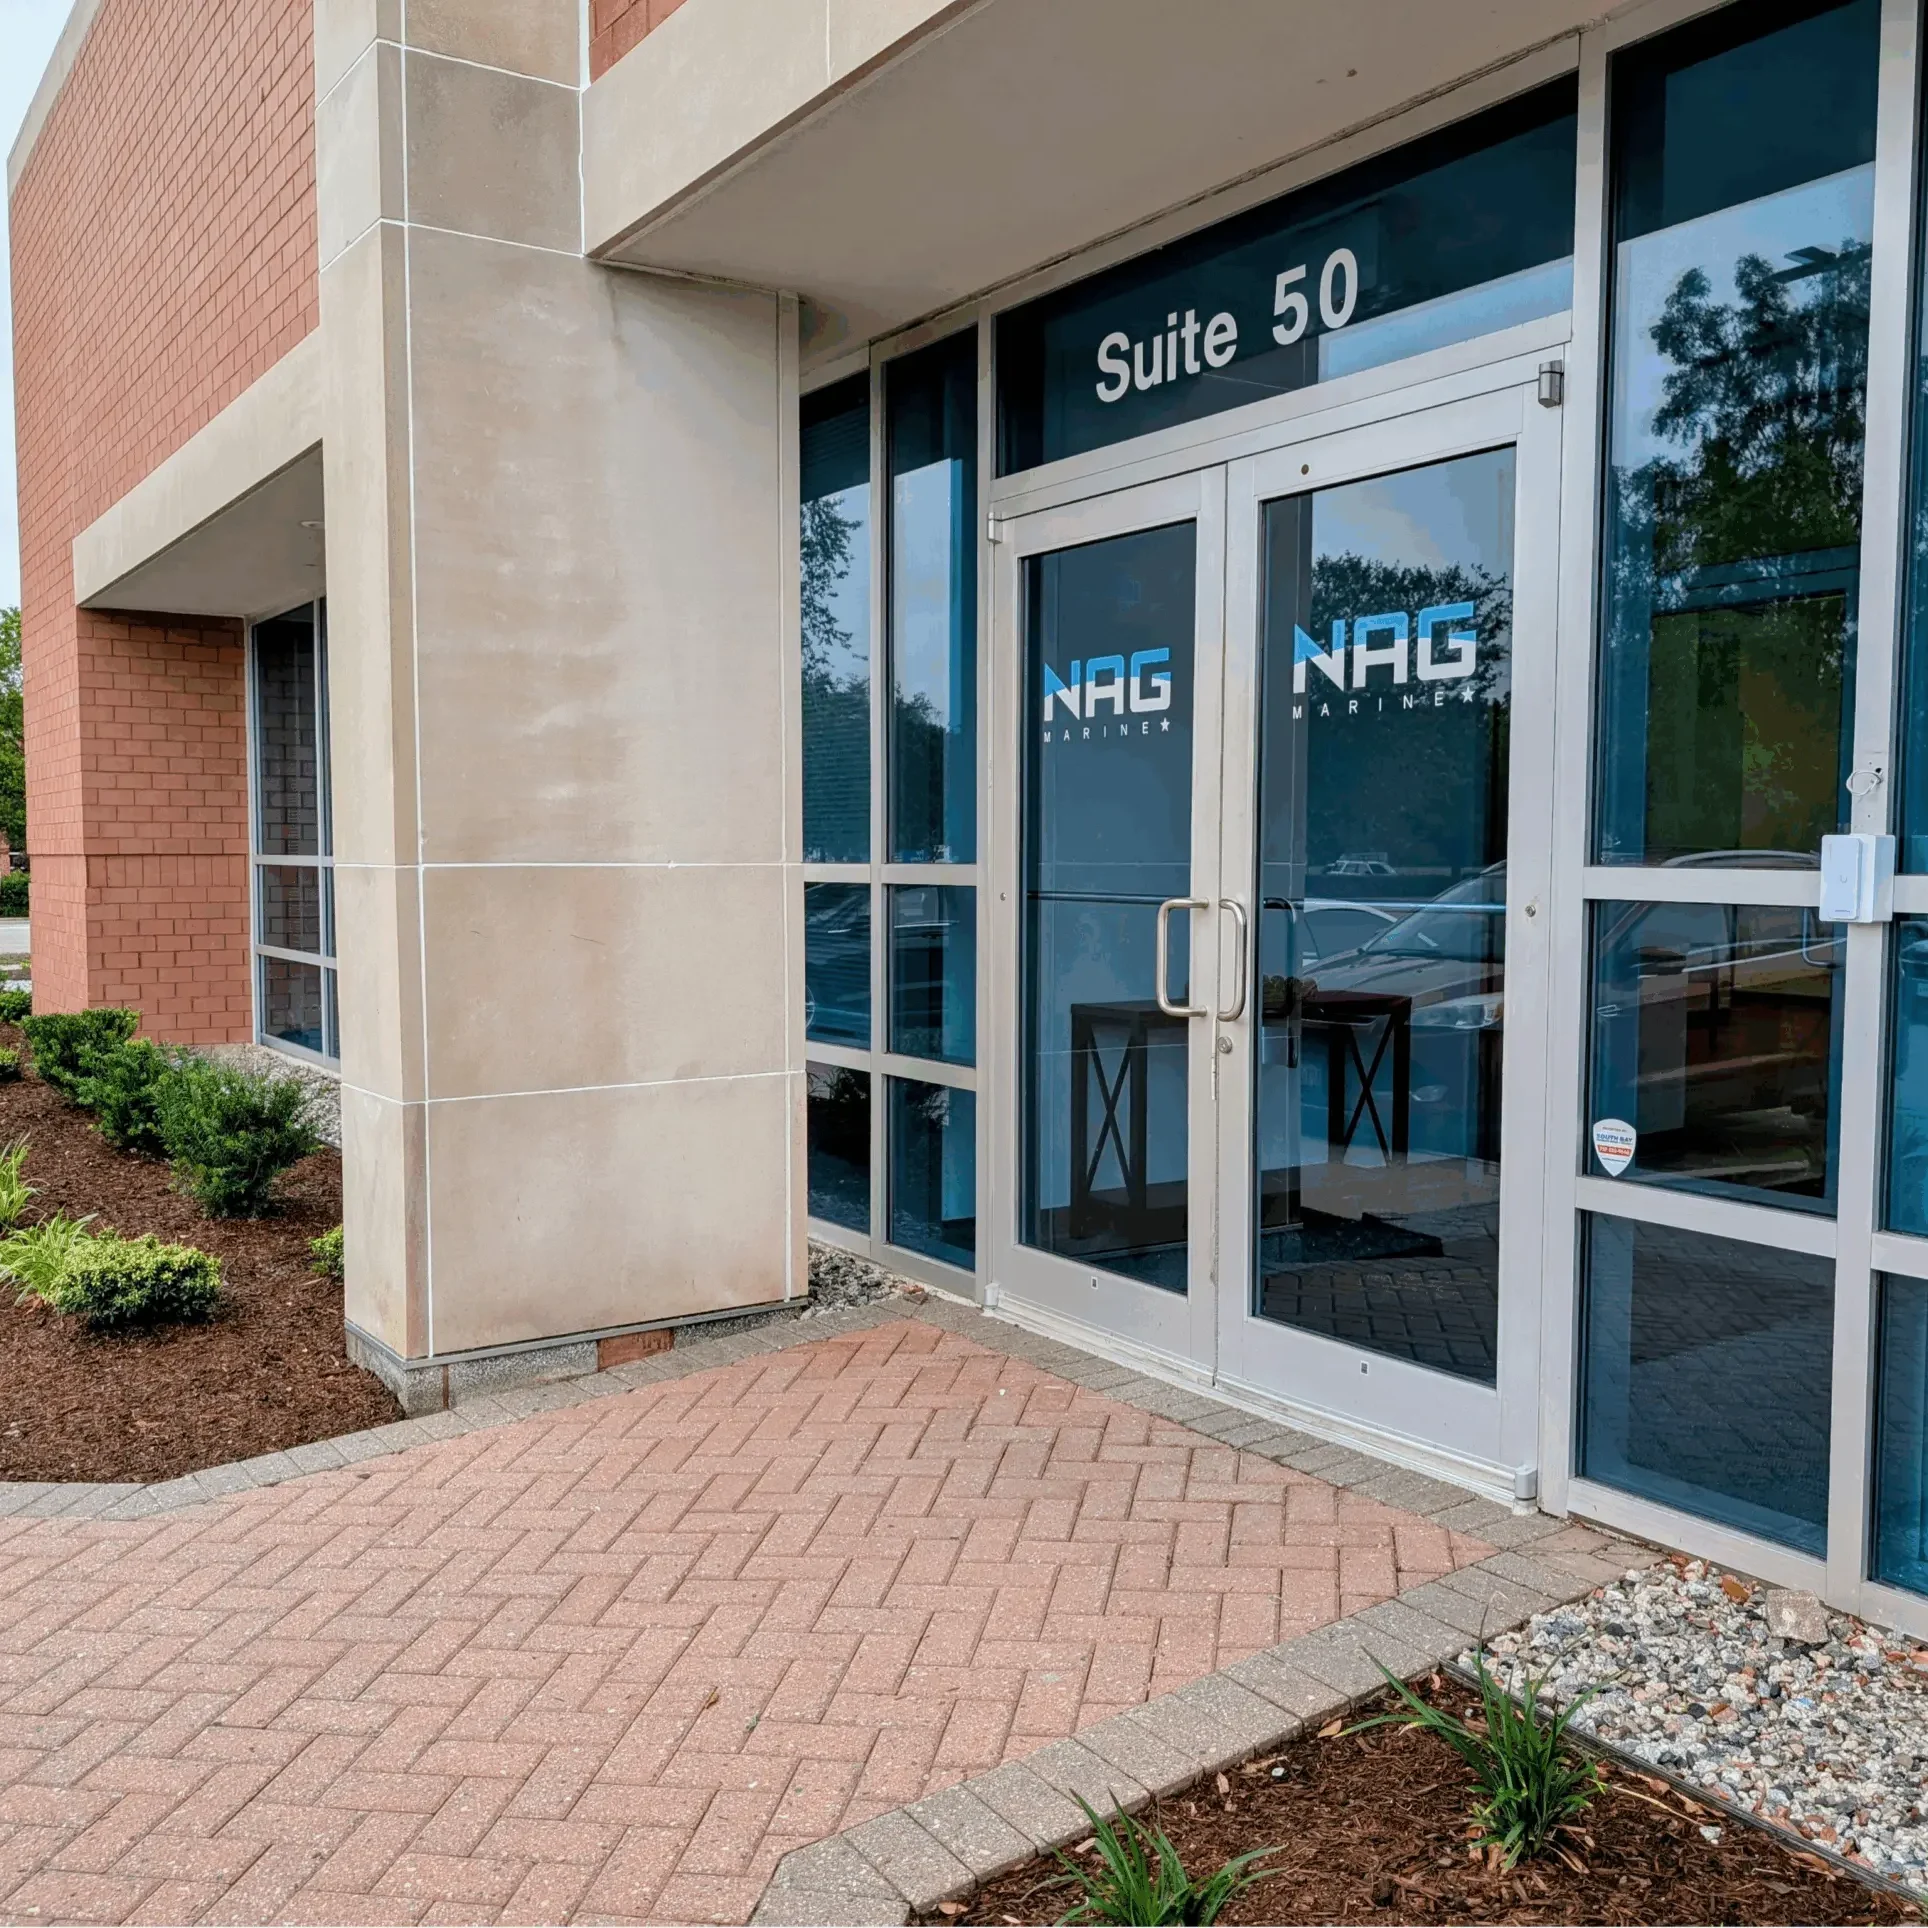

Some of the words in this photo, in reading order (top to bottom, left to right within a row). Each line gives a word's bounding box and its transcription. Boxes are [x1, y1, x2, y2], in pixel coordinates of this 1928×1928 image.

[1096, 309, 1238, 403] Suite
[1272, 248, 1358, 346] 50
[1293, 601, 1477, 694] NAG
[1044, 647, 1172, 721] NAG
[1292, 691, 1444, 720] MARINE
[1044, 721, 1149, 743] MARINE
[1596, 1133, 1619, 1142] SOUTH
